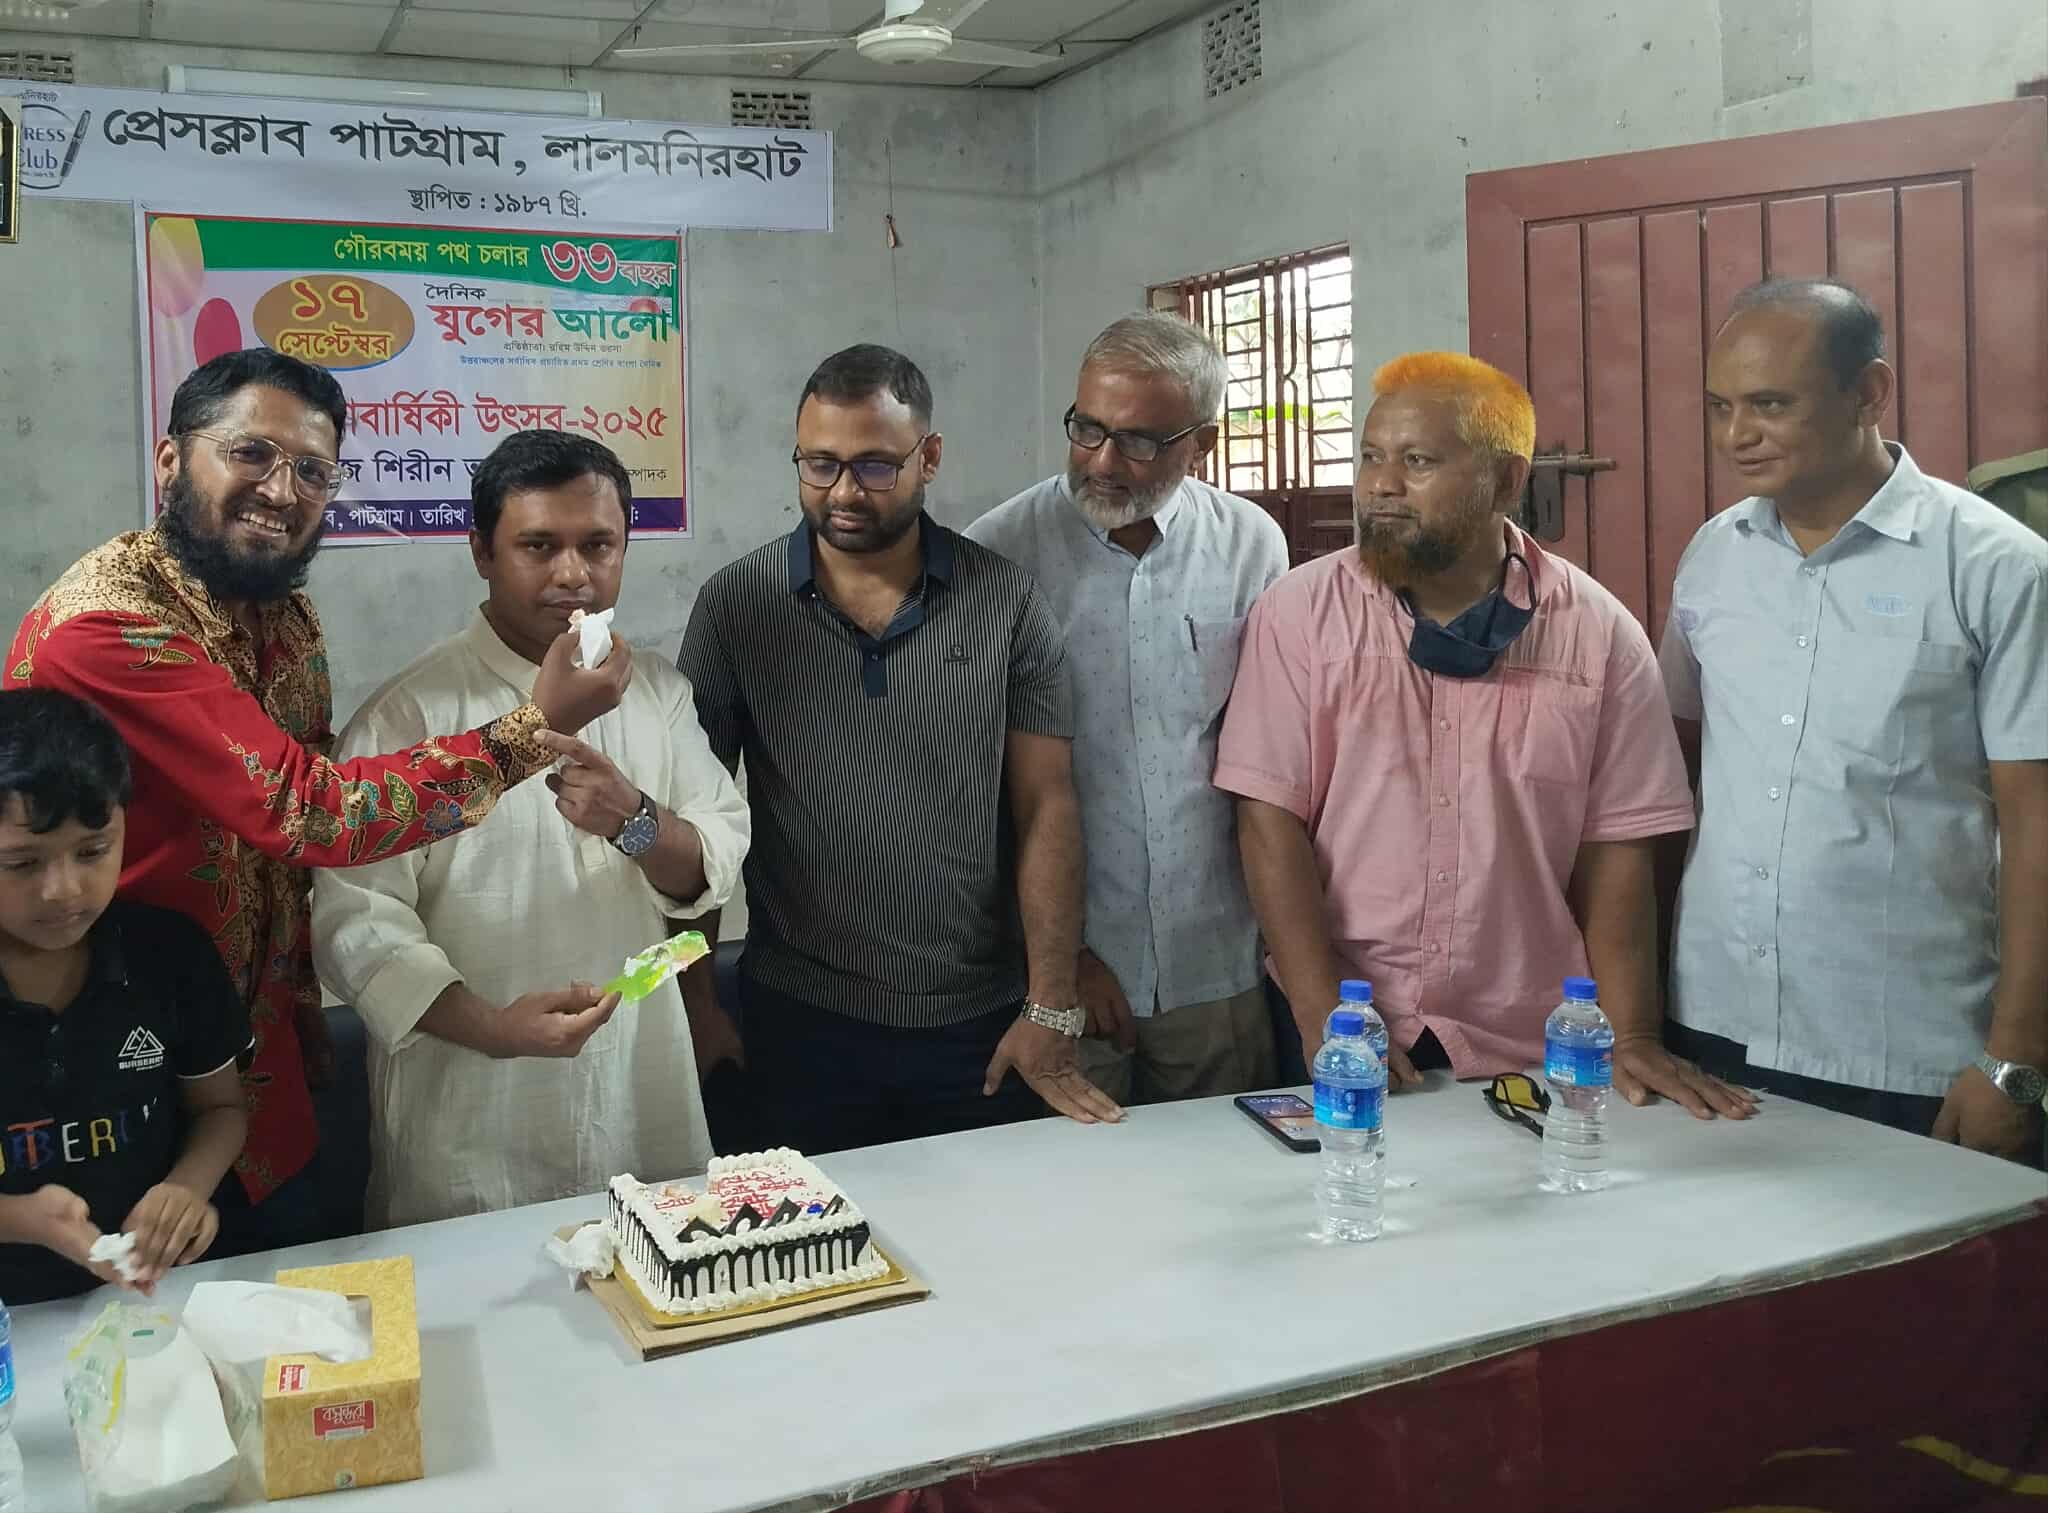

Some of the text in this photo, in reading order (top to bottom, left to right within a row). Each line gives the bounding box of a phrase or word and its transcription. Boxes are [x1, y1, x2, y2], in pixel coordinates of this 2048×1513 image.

[23, 127, 66, 142] RESS
[103, 106, 312, 158] প্রেসক্লাব
[541, 129, 808, 182] লালমনিরহাট
[20, 147, 58, 169] lub
[407, 184, 472, 211] স্থাপিত
[493, 192, 552, 216] ১৯৮৭
[334, 231, 675, 289] গৌরবময় পথ চলার ৩৩ বছর
[291, 278, 368, 321] ১৭
[424, 282, 488, 301] দৈনিক
[426, 303, 673, 345] যুগের আলো
[371, 449, 456, 482] শিরীন
[419, 502, 467, 526] তারিখ
